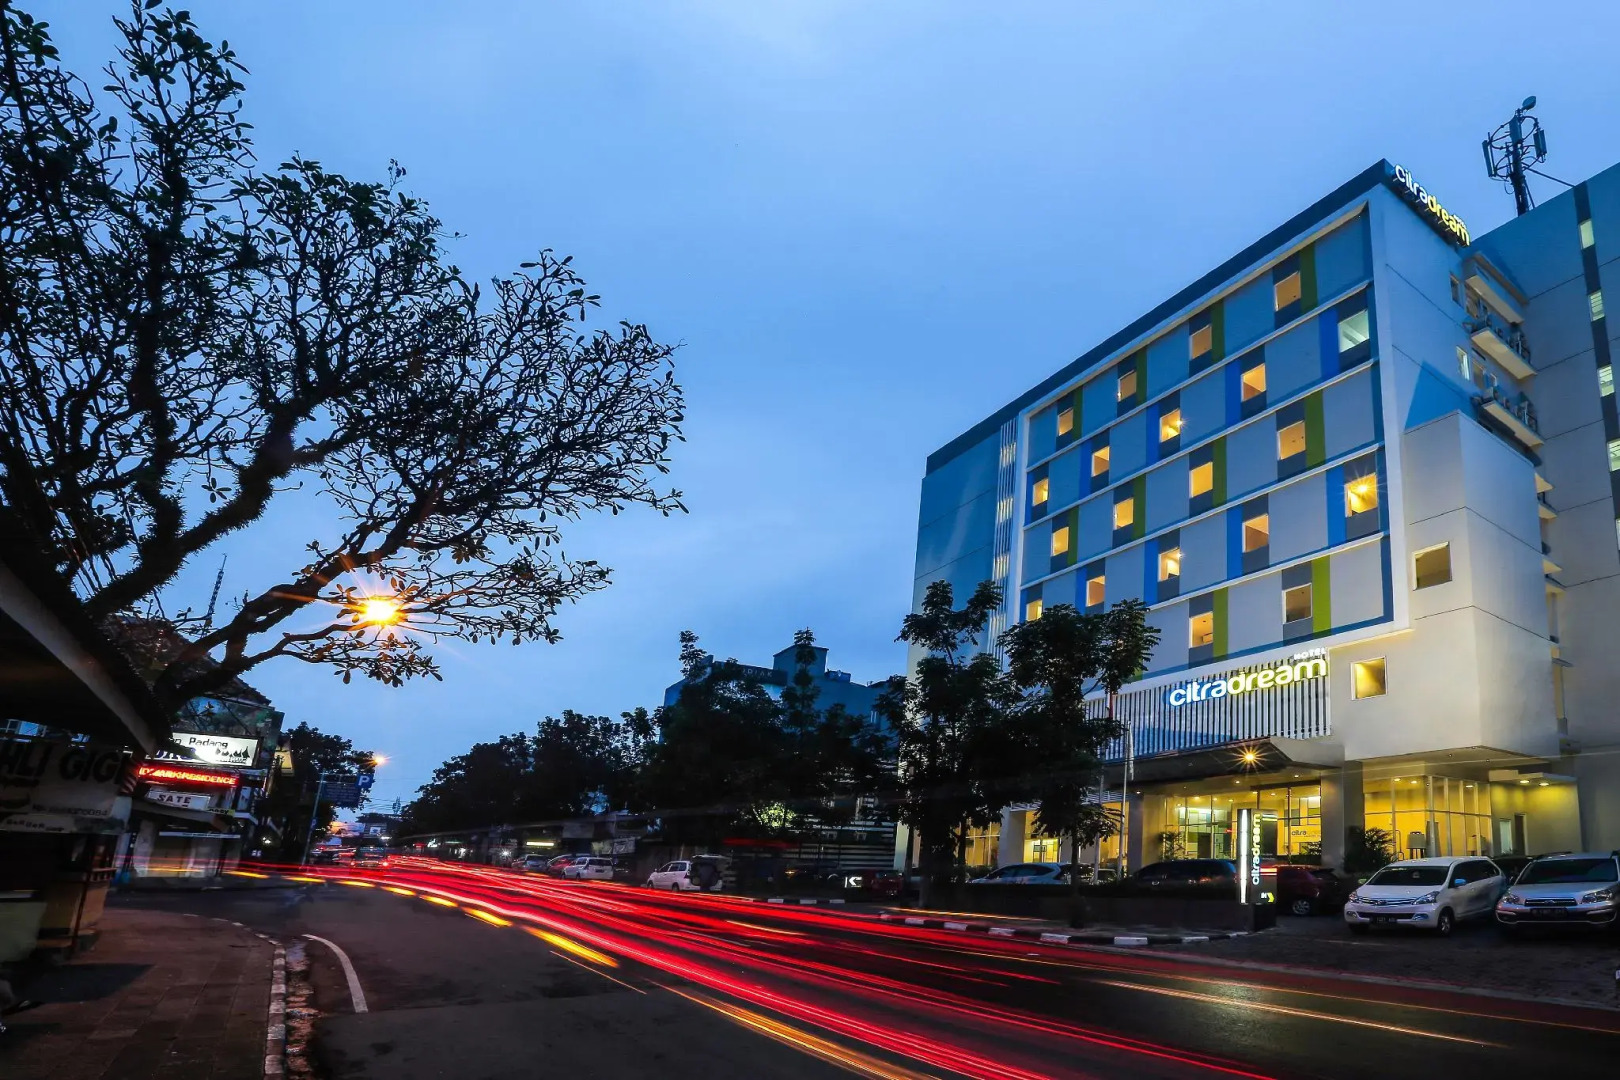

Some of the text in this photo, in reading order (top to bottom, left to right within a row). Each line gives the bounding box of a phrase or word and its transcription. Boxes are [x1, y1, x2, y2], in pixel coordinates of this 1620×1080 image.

[1395, 164, 1470, 246] citradream
[1293, 647, 1326, 660] HOTEL
[1169, 659, 1327, 707] citradream
[189, 737, 228, 749] Padang
[358, 775, 370, 786] P
[157, 795, 191, 804] SATE
[1251, 813, 1261, 885] citradream
